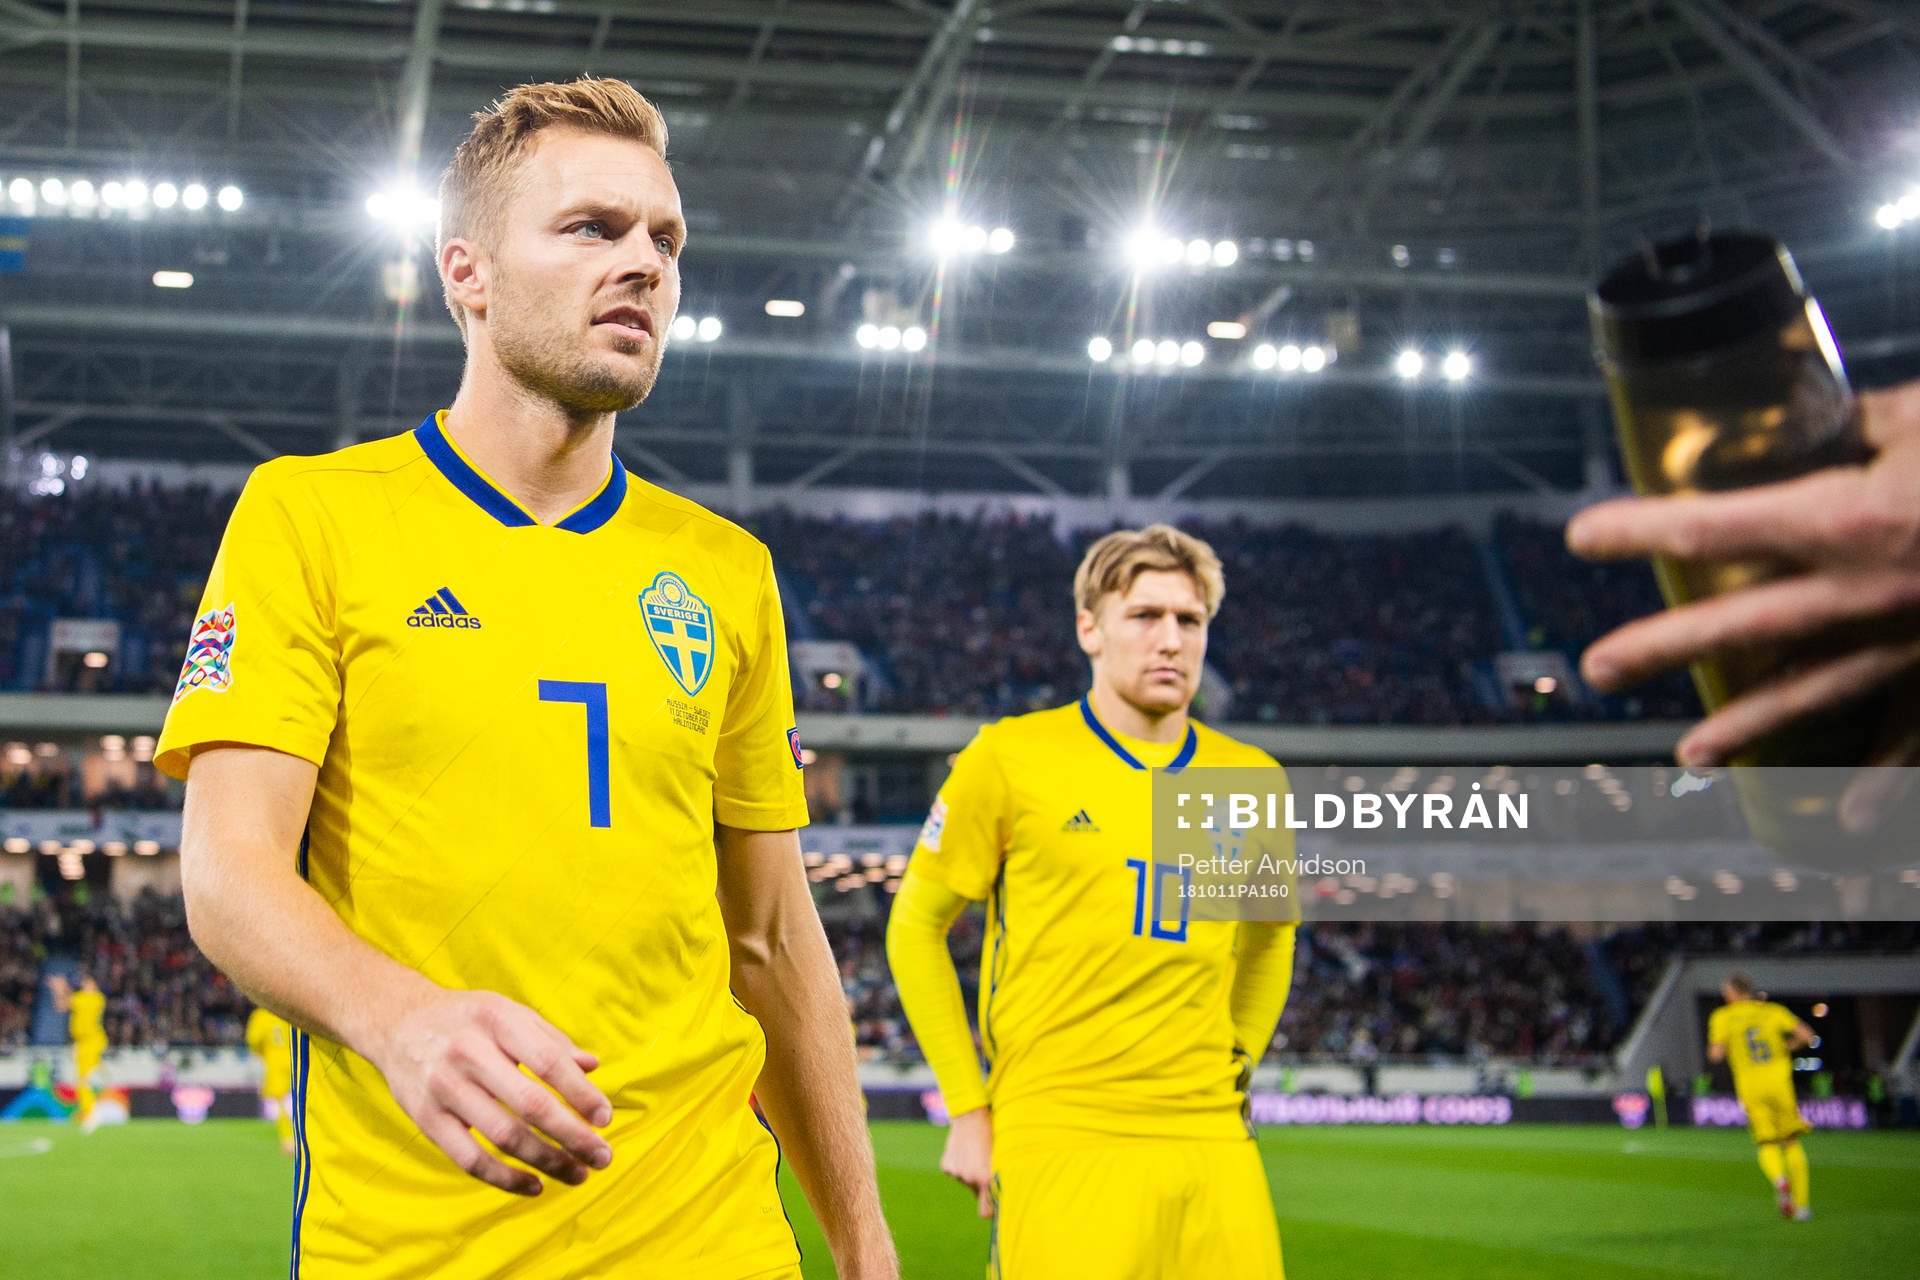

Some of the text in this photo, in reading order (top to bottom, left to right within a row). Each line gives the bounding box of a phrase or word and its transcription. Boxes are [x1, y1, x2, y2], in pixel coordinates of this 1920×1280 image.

[407, 613, 482, 629] adidas
[654, 606, 699, 621] SVERIGE
[539, 680, 610, 828] 7
[1126, 858, 1191, 943] 10
[1746, 1027, 1772, 1064] 6
